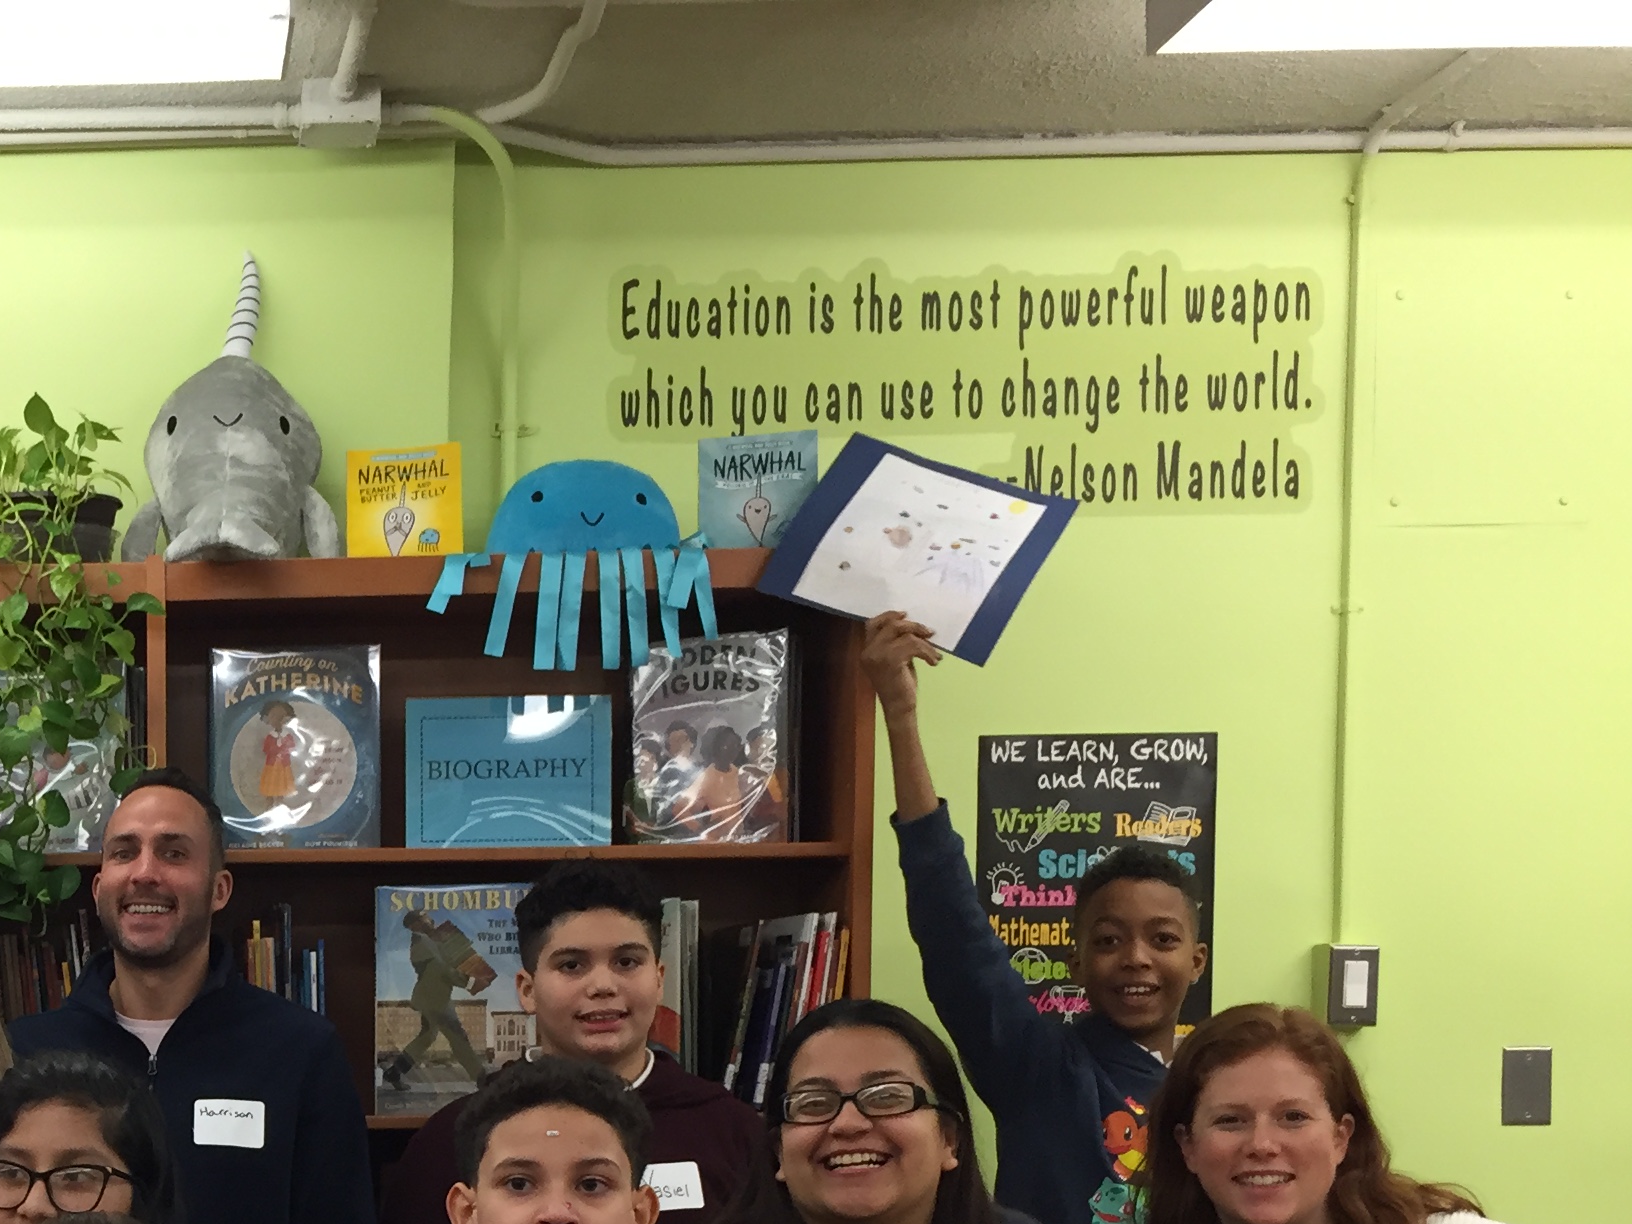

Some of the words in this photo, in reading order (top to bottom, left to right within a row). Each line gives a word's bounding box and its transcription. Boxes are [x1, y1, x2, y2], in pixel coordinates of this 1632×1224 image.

[622, 279, 791, 339] Education
[810, 282, 835, 334] is
[854, 273, 903, 333] the
[922, 278, 1001, 332] most
[1019, 265, 1167, 350] powerful
[1185, 277, 1311, 343] weapon
[620, 366, 713, 428] which
[731, 383, 787, 436] you
[806, 381, 862, 423] can
[880, 380, 934, 420] use
[953, 369, 983, 418] to
[1002, 357, 1121, 433] change
[1139, 354, 1189, 413] the
[1207, 350, 1312, 412] world.
[358, 459, 449, 485] NARWHAL
[714, 451, 806, 481] NARWHAL
[1157, 439, 1299, 501] Mandela
[360, 485, 396, 496] PEANUT
[361, 493, 397, 503] BUTTER
[411, 486, 447, 501] JELLY
[246, 654, 315, 675] Counting
[318, 660, 338, 671] on
[225, 673, 363, 708] KATHERINE
[990, 740, 1026, 764] WE
[1037, 739, 1119, 766] LEARN,
[1130, 737, 1208, 766] GROW,
[427, 756, 587, 782] BIOGRAPHY
[1038, 765, 1085, 789] and
[1094, 767, 1161, 791] ARE...
[992, 804, 1102, 834] Writers
[1113, 812, 1203, 838] Readers
[390, 890, 528, 912] SCHOMBU
[200, 1107, 253, 1119] Harrison
